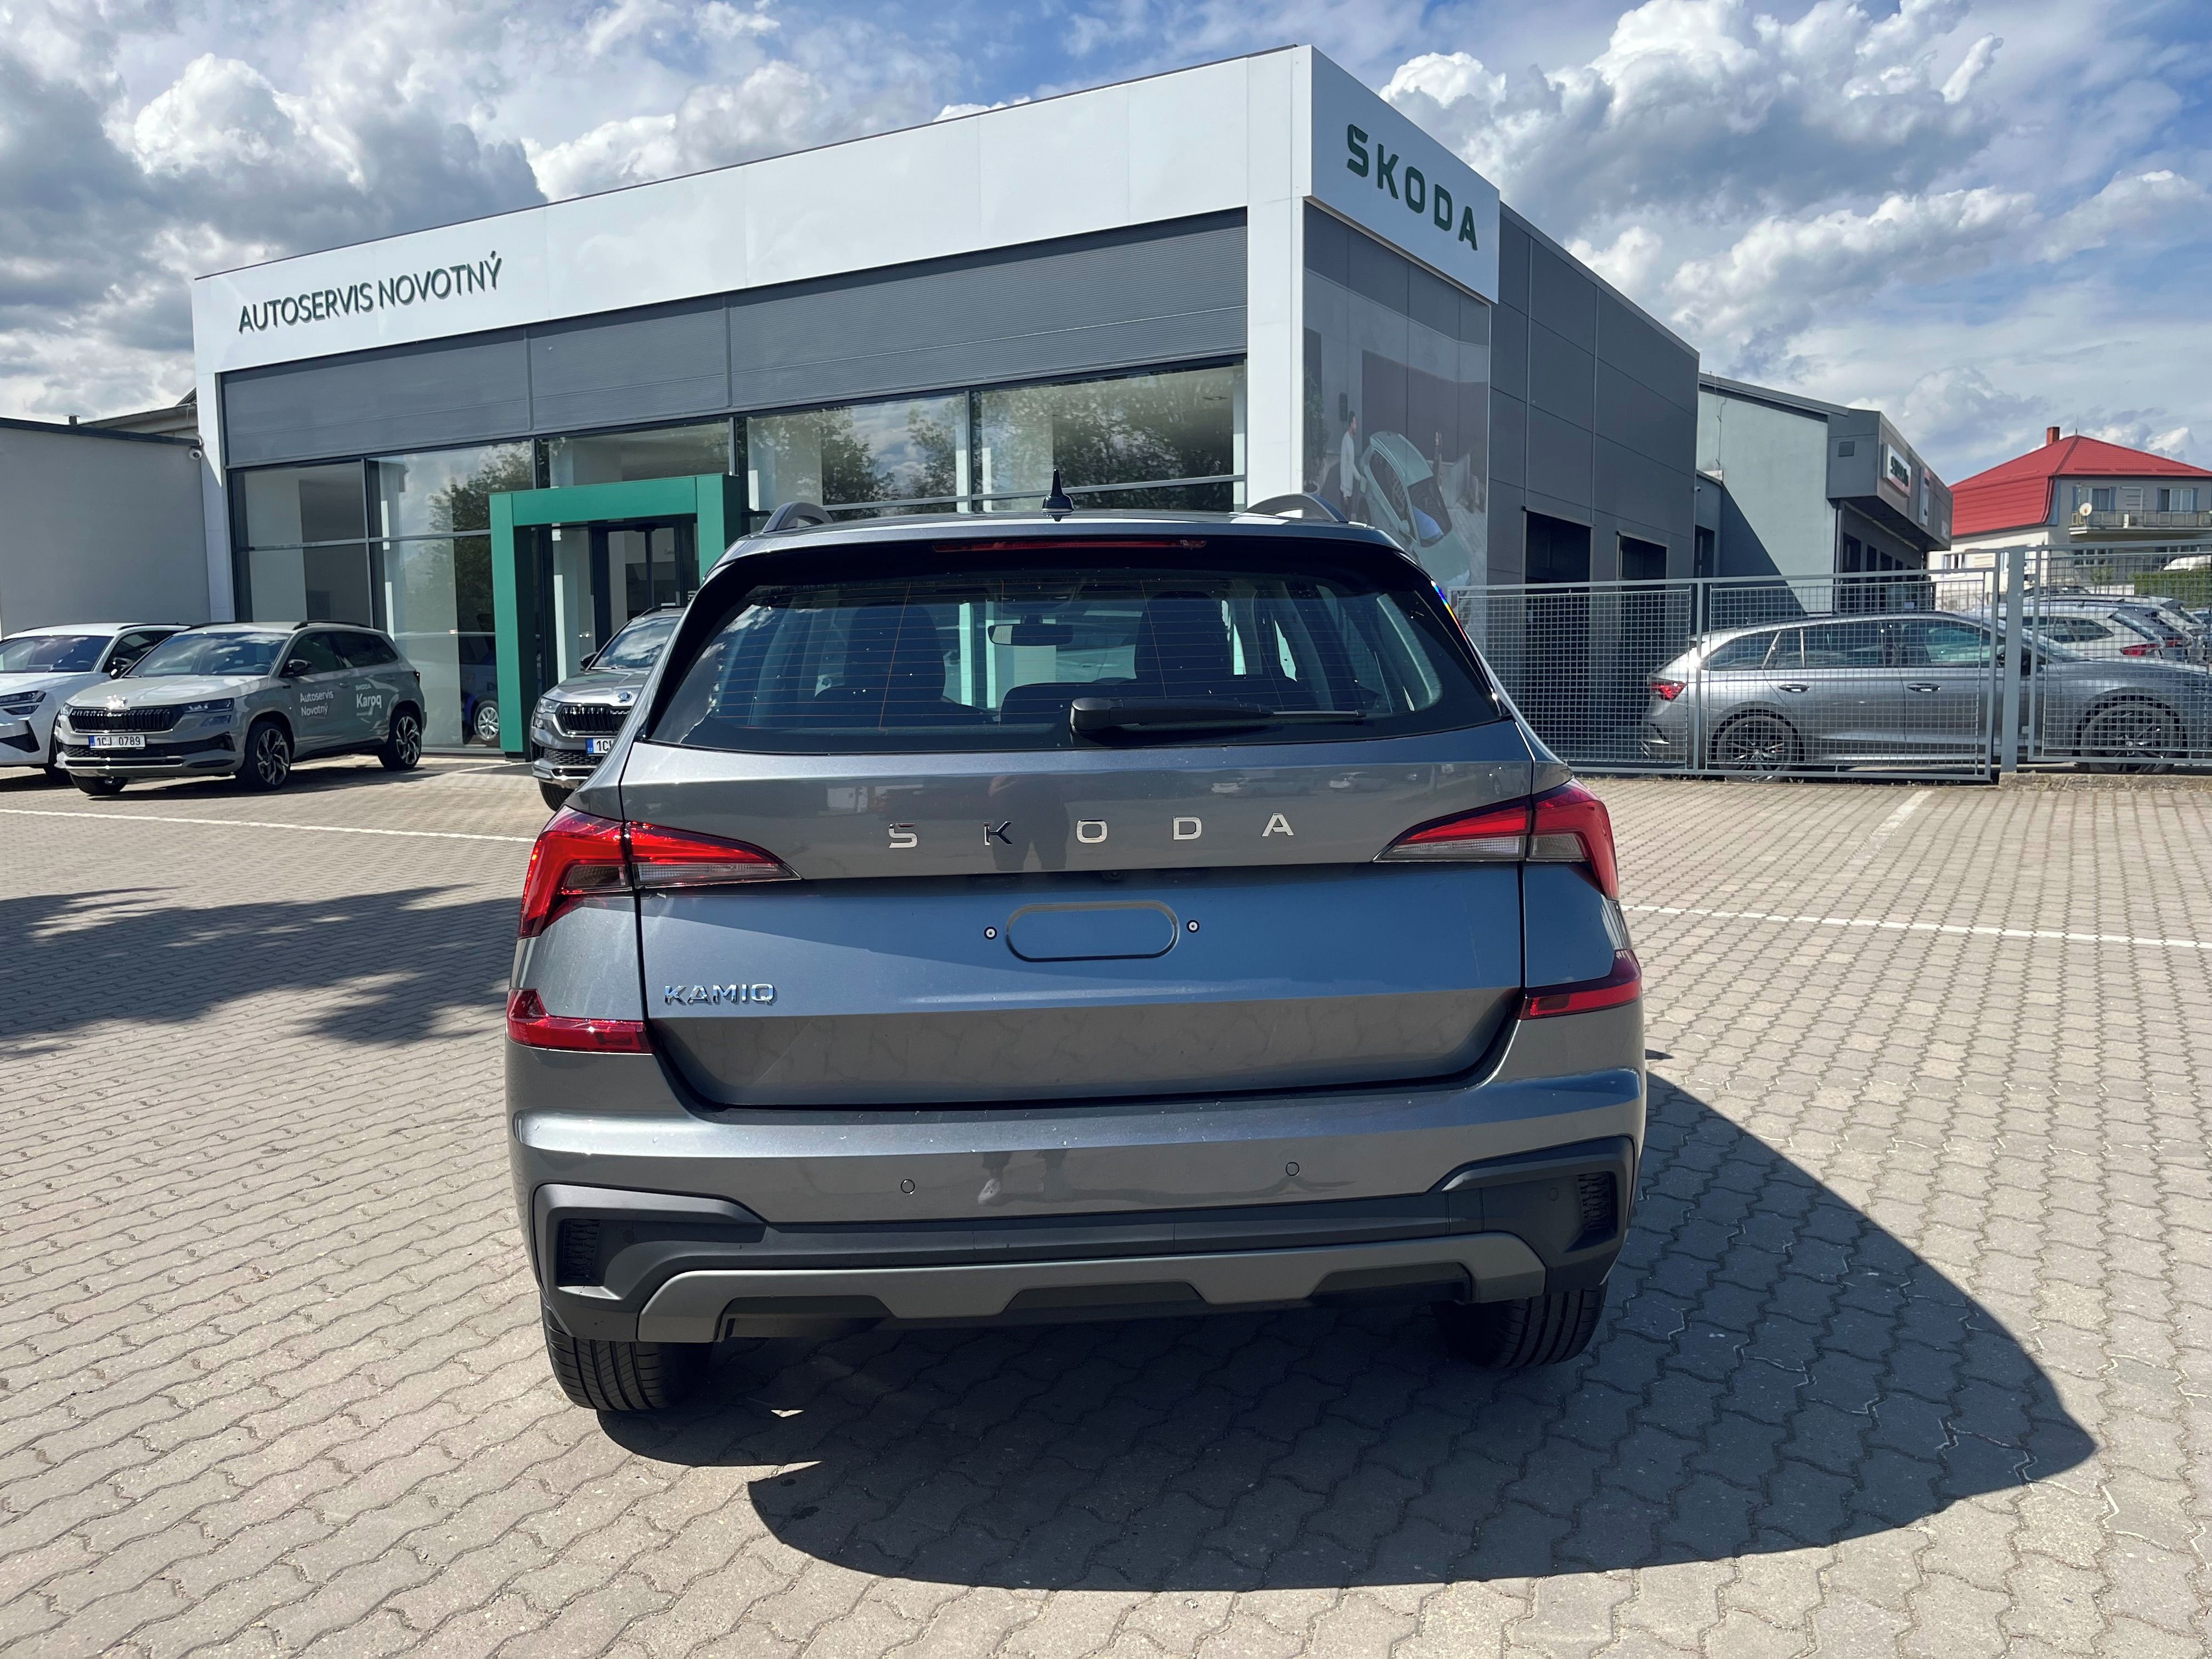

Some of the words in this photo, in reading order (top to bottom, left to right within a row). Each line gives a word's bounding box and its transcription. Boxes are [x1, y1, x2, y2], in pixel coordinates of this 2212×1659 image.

[238, 282, 374, 334] AUTOSERVIS
[378, 250, 503, 309] NOVOTNÝ
[300, 689, 334, 703] Autoservis
[357, 693, 382, 708] Karoq
[301, 703, 329, 716] Novotný
[97, 737, 112, 746] 1CJ
[119, 736, 140, 746] 0789
[664, 984, 776, 1005] KAMIQ
